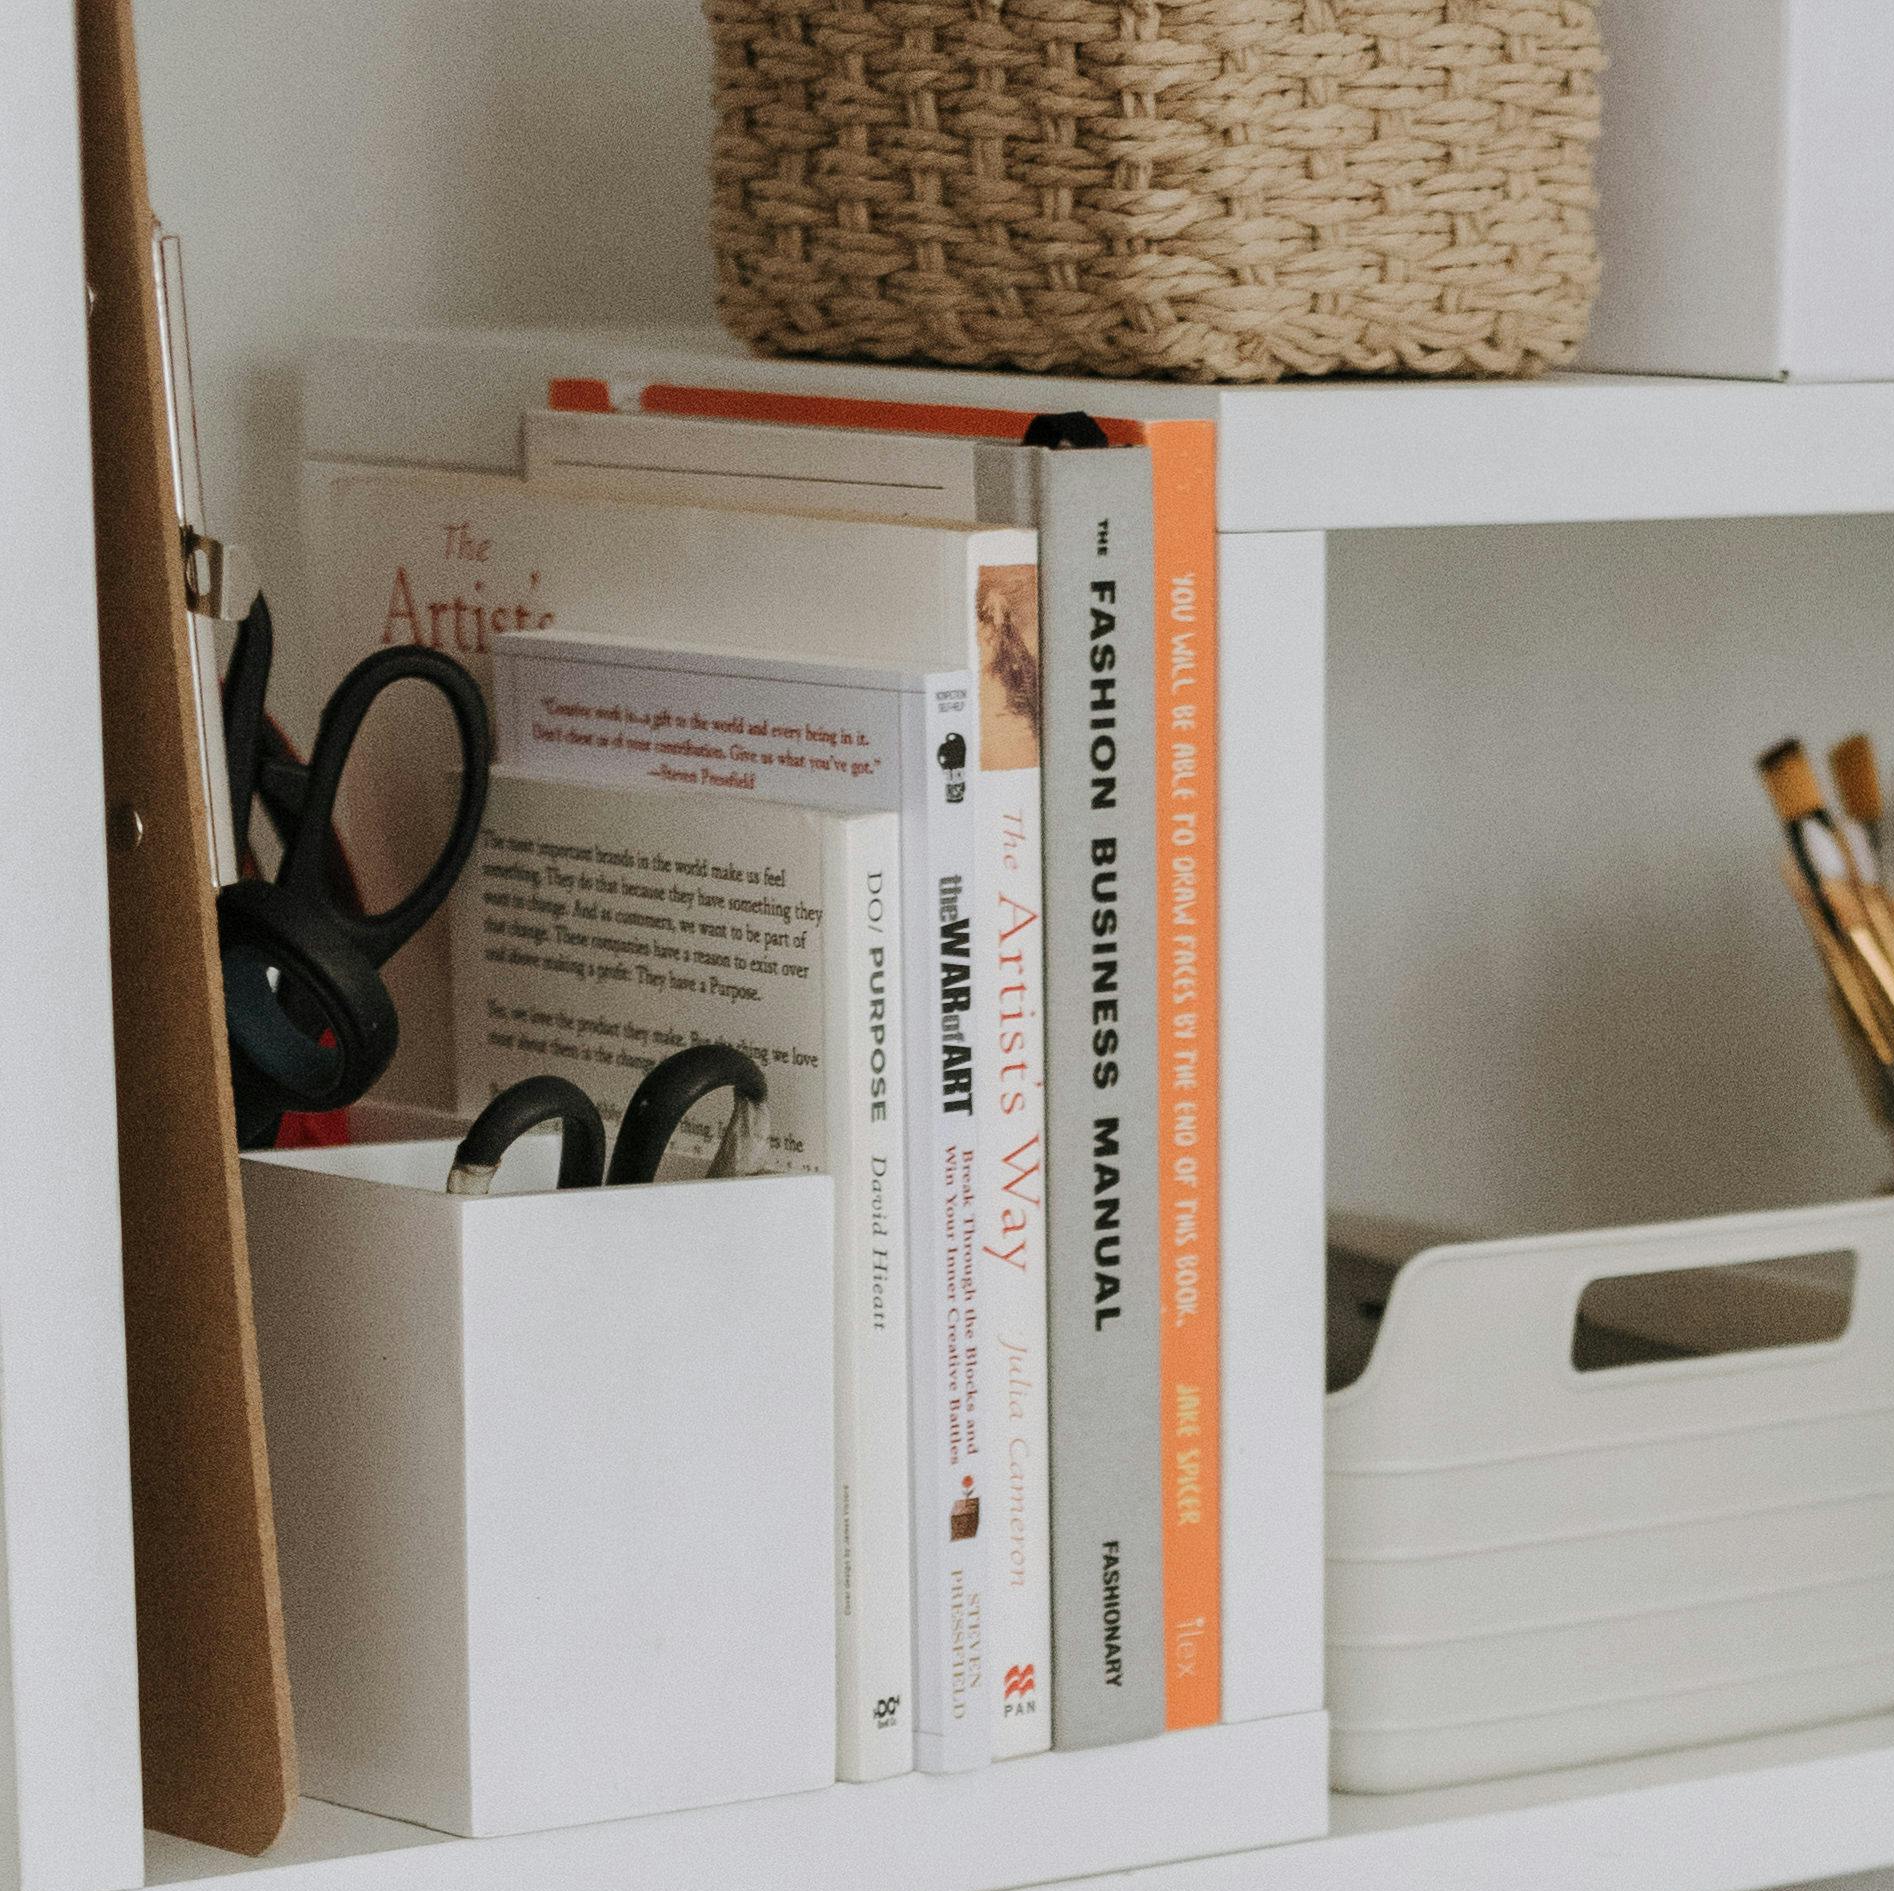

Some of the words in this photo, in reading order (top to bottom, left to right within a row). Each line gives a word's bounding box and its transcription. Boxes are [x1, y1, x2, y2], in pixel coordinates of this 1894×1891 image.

[443, 521, 491, 561] The
[1097, 518, 1109, 556] THE
[1170, 572, 1196, 622] YOU
[1170, 631, 1196, 693] WILL
[1089, 580, 1118, 811] FASHION
[1170, 705, 1196, 731] BE
[689, 712, 708, 731] the
[711, 716, 744, 735] world
[747, 718, 768, 737] and
[771, 723, 801, 743] every
[804, 722, 837, 746] being
[841, 728, 853, 745] in
[856, 729, 869, 747] it.
[729, 743, 757, 763] Give
[760, 752, 774, 765] us
[776, 750, 806, 768] what
[808, 756, 847, 773] you've
[1170, 742, 1196, 800] ABLE
[1002, 808, 1022, 872] The
[1171, 812, 1196, 847] TO
[637, 854, 649, 869] in
[652, 852, 672, 874] the
[674, 857, 708, 880] world
[710, 862, 744, 883] make
[746, 868, 760, 885] us
[762, 866, 786, 888] feel
[1172, 854, 1197, 925] DRAW
[621, 877, 665, 903] because
[669, 884, 696, 909] they
[697, 888, 726, 911] have
[727, 894, 792, 924] something
[793, 901, 824, 928] they
[653, 938, 681, 961] have
[692, 949, 731, 969] reason
[733, 953, 748, 970] to
[749, 953, 779, 976] exist
[780, 961, 809, 980] over
[678, 918, 696, 934] we
[698, 920, 728, 940] want
[730, 925, 743, 942] to
[745, 922, 762, 944] be
[763, 930, 791, 951] part
[792, 930, 808, 950] of
[636, 962, 667, 991] They
[669, 971, 697, 991] have
[709, 975, 761, 1004] Purpose.
[1089, 837, 1121, 1091] BUSINESS
[1172, 934, 1197, 1003] FACES
[998, 891, 1044, 1116] Artist's
[1172, 1013, 1197, 1040] BY
[772, 1048, 790, 1064] we
[791, 1046, 819, 1068] love
[869, 946, 887, 1124] PURPOSE
[1173, 1050, 1197, 1090] THE
[783, 1133, 804, 1153] the
[1173, 1101, 1198, 1148] END
[945, 1144, 959, 1187] Win
[961, 1149, 975, 1208] Break
[1174, 1156, 1198, 1190] OF
[870, 1154, 888, 1237] David
[945, 1194, 960, 1242] Your
[981, 1132, 1041, 1273] Way
[1174, 1198, 1199, 1248] THIS
[1092, 1117, 1123, 1333] MANUAL
[946, 1247, 961, 1303] Inner
[960, 1216, 978, 1302] Through
[871, 1246, 889, 1332] Hieatt
[947, 1307, 963, 1393] Creative
[964, 1308, 979, 1341] the
[964, 1346, 979, 1413] Blocks
[999, 1334, 1032, 1422] Julia
[949, 1398, 963, 1466] Battles
[965, 1418, 980, 1457] and
[1175, 1384, 1200, 1438] JAKE
[1006, 1434, 1032, 1590] Cameron
[1175, 1448, 1202, 1527] SPICER
[966, 1591, 982, 1689] STEVEN
[1101, 1540, 1123, 1689] FASHIONARY
[950, 1568, 967, 1720] PRESSFIELD
[1003, 1700, 1038, 1718] PAN
